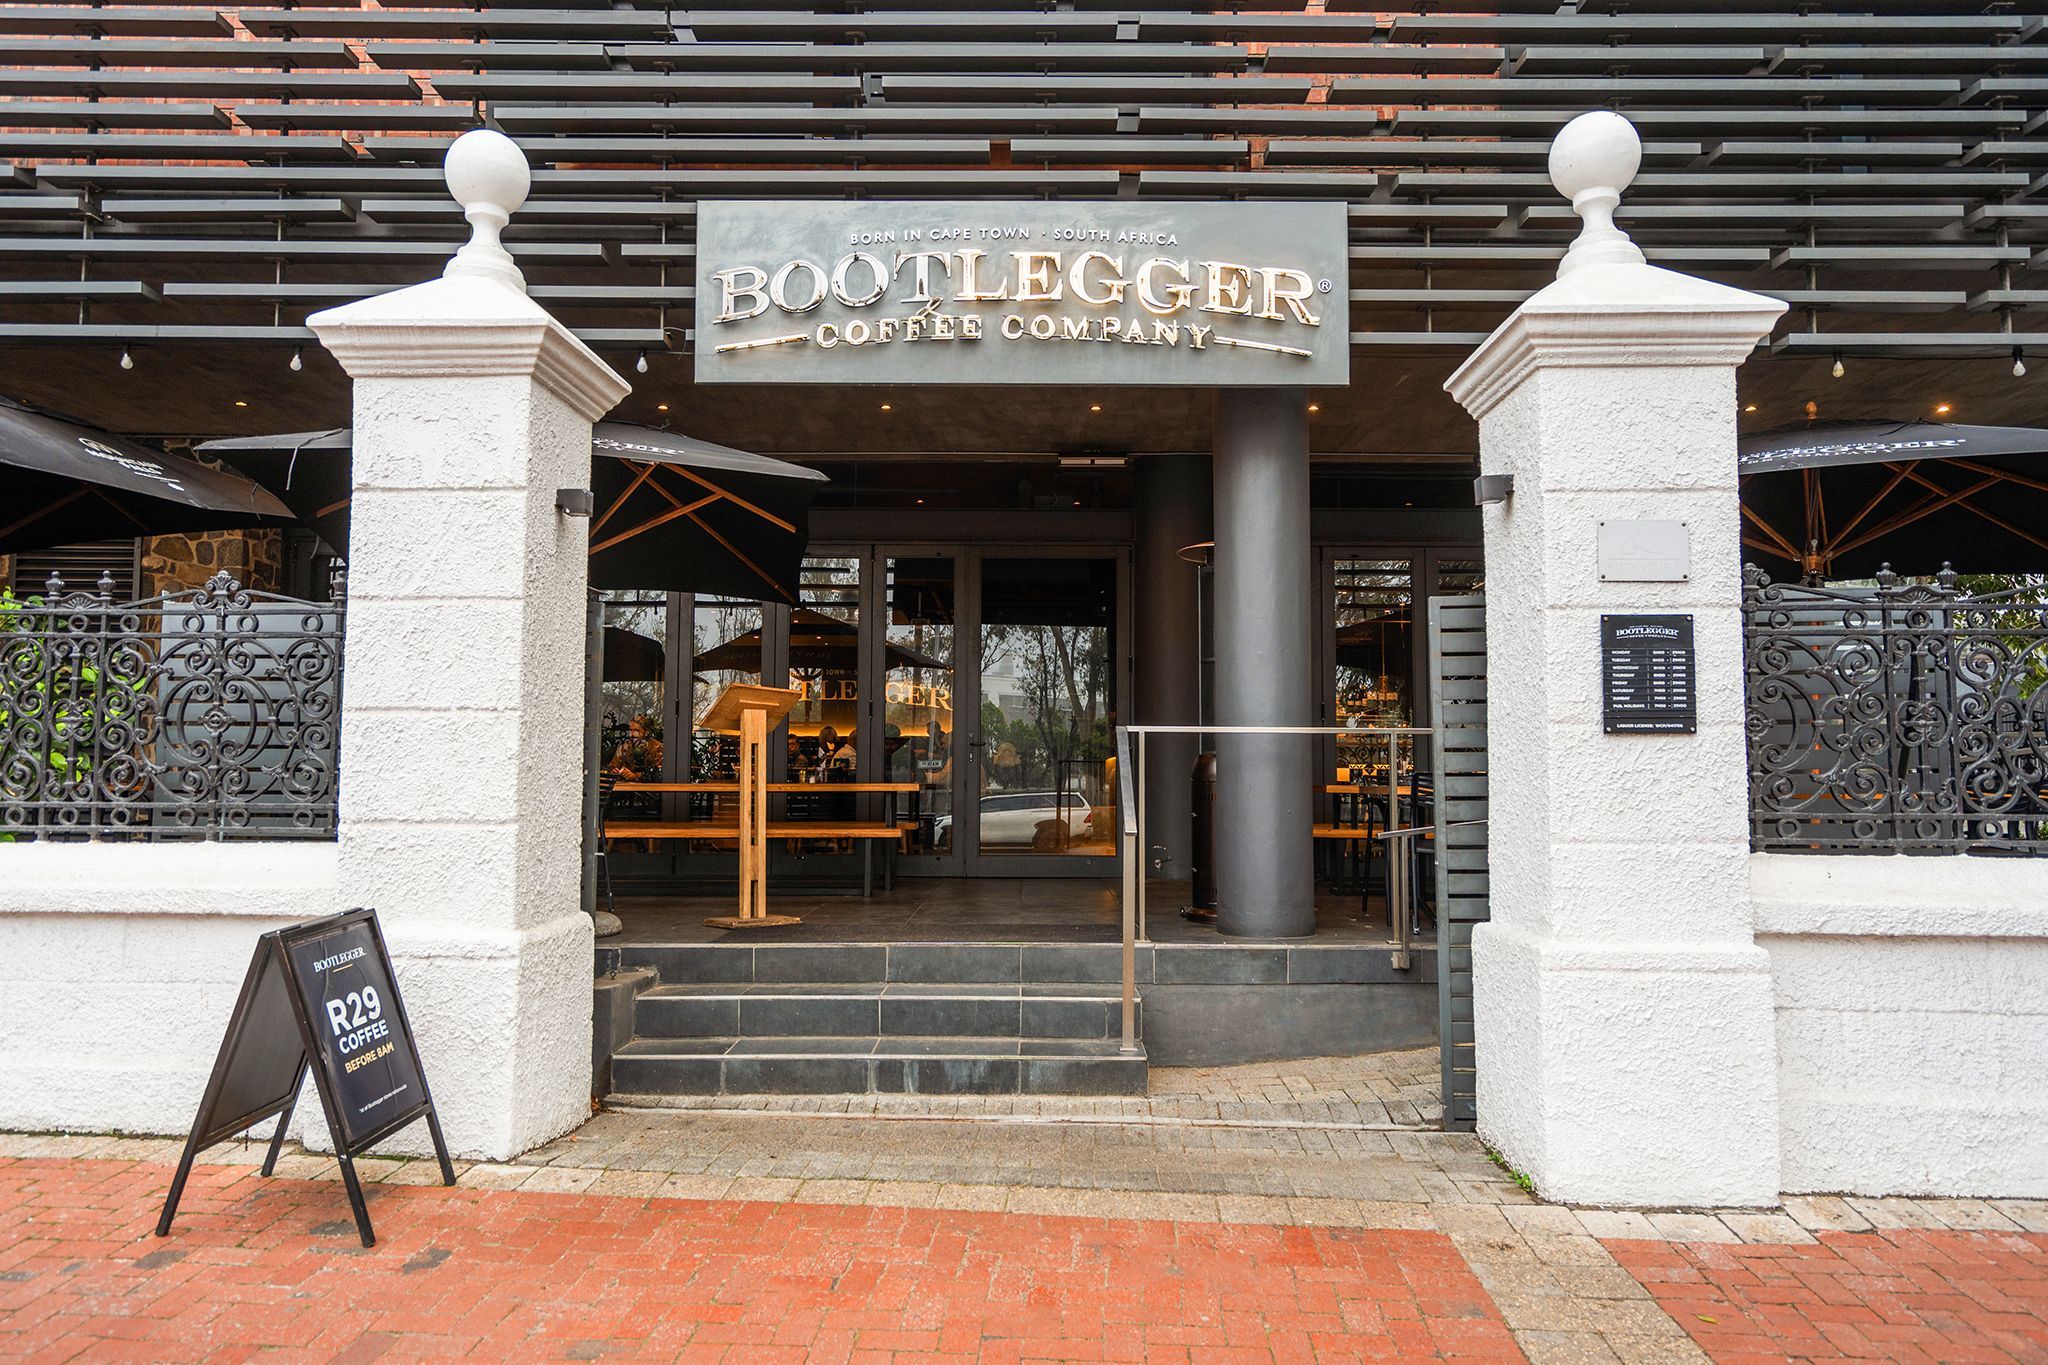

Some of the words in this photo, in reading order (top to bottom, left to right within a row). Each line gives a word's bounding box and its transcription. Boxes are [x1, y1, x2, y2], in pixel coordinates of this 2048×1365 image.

[850, 231, 895, 245] BORN
[903, 229, 921, 242] IN
[929, 228, 971, 241] CAPE
[979, 227, 1030, 240] TOWN
[1054, 228, 1111, 242] SOUTH
[1118, 231, 1178, 246] AFRICA
[816, 314, 983, 349] COFFEE
[1002, 313, 1213, 350] COMPANY
[325, 985, 381, 1036] R29
[339, 1019, 389, 1054] COFFEE
[345, 1051, 377, 1073] BEFORE
[377, 1041, 394, 1060] 8AM
